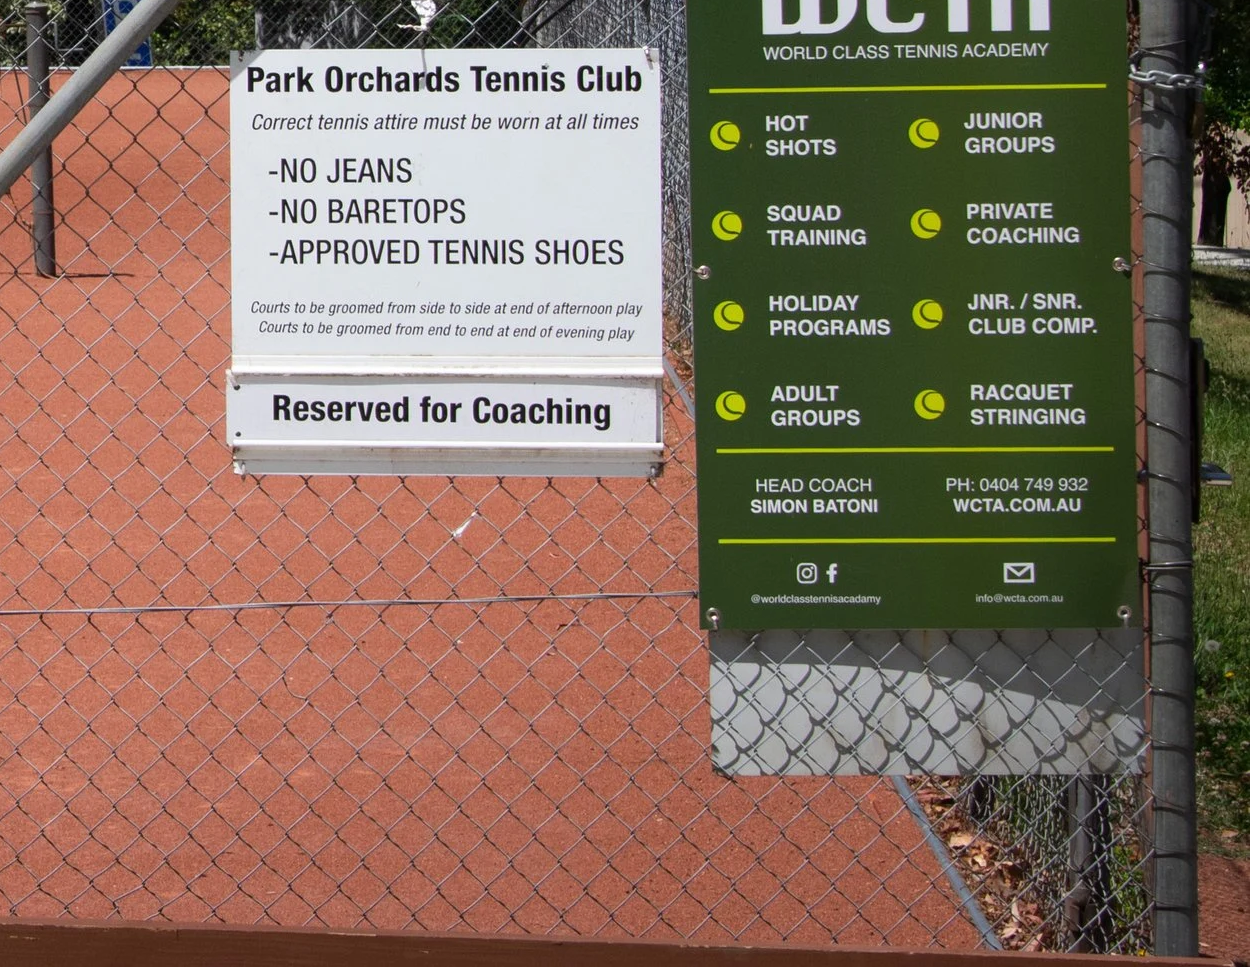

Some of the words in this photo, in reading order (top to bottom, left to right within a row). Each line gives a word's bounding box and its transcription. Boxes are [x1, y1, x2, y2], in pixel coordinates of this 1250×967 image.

[763, 46, 827, 60] WORLD
[833, 45, 889, 59] CLASS
[894, 44, 957, 58] TENNIS
[962, 43, 1048, 57] ACADEMY
[247, 67, 314, 92] Park
[325, 66, 459, 92] Orchards
[470, 66, 565, 92] Tennis
[577, 65, 641, 92] Club
[252, 114, 313, 130] Correct
[319, 114, 368, 130] tennis
[374, 114, 418, 130] attire
[424, 114, 466, 130] must
[471, 114, 491, 129] be
[499, 117, 539, 129] worn
[545, 114, 562, 129] at
[567, 114, 587, 129] all
[593, 113, 639, 129] times
[766, 115, 808, 131] HOT
[964, 112, 1042, 129] JUNIOR
[766, 139, 836, 156] SHOTS
[965, 136, 1055, 153] GROUPS
[327, 158, 412, 183] JEANS
[329, 199, 465, 224] BARETOPS
[767, 205, 841, 222] SQUAD
[967, 203, 1053, 219] PRIVATE
[767, 229, 866, 245] TRAINING
[967, 227, 1079, 244] COACHING
[428, 240, 524, 264] TENNIS
[535, 240, 624, 265] SHOES
[251, 301, 290, 313] Courts
[295, 302, 306, 313] to
[310, 302, 325, 313] be
[329, 302, 384, 316] groomed
[388, 302, 415, 313] from
[420, 302, 445, 314] side
[450, 302, 461, 314] to
[465, 302, 490, 314] side
[494, 303, 507, 314] at
[510, 302, 534, 314] end
[537, 302, 550, 314] of
[553, 302, 612, 314] afternoon
[616, 303, 642, 317] play
[769, 295, 859, 311] HOLIDAY
[968, 294, 1014, 310] JNR.
[1020, 293, 1028, 309] /
[1033, 293, 1082, 309] SNR.
[259, 321, 298, 333] Courts
[303, 322, 314, 333] to
[318, 322, 333, 334] be
[337, 323, 392, 337] groomed
[396, 323, 424, 335] from
[428, 324, 451, 336] end
[455, 325, 466, 336] to
[471, 325, 494, 336] end
[497, 326, 510, 337] at
[513, 326, 536, 337] end
[540, 326, 553, 337] of
[556, 326, 605, 341] evening
[608, 327, 635, 342] play
[770, 319, 890, 336] PROGRAMS
[969, 318, 1025, 334] CLUB
[1032, 317, 1097, 334] COMP.
[771, 386, 839, 402] ADULT
[971, 384, 1073, 400] RACQUET
[273, 395, 409, 422] Reserved
[420, 396, 462, 423] for
[473, 397, 610, 431] Coaching
[771, 409, 860, 426] GROUPS
[971, 408, 1085, 425] STRINGING
[756, 479, 803, 492] HEAD
[809, 478, 871, 492] COACH
[946, 478, 974, 491] PH:
[980, 478, 1019, 491] 0404
[1024, 478, 1053, 491] 749
[1058, 478, 1088, 491] 932
[751, 499, 807, 513] SIMON
[813, 499, 877, 513] BATONI
[953, 498, 1081, 512] WCTA.COM.AU
[976, 594, 1063, 602] info@wcta.com.au
